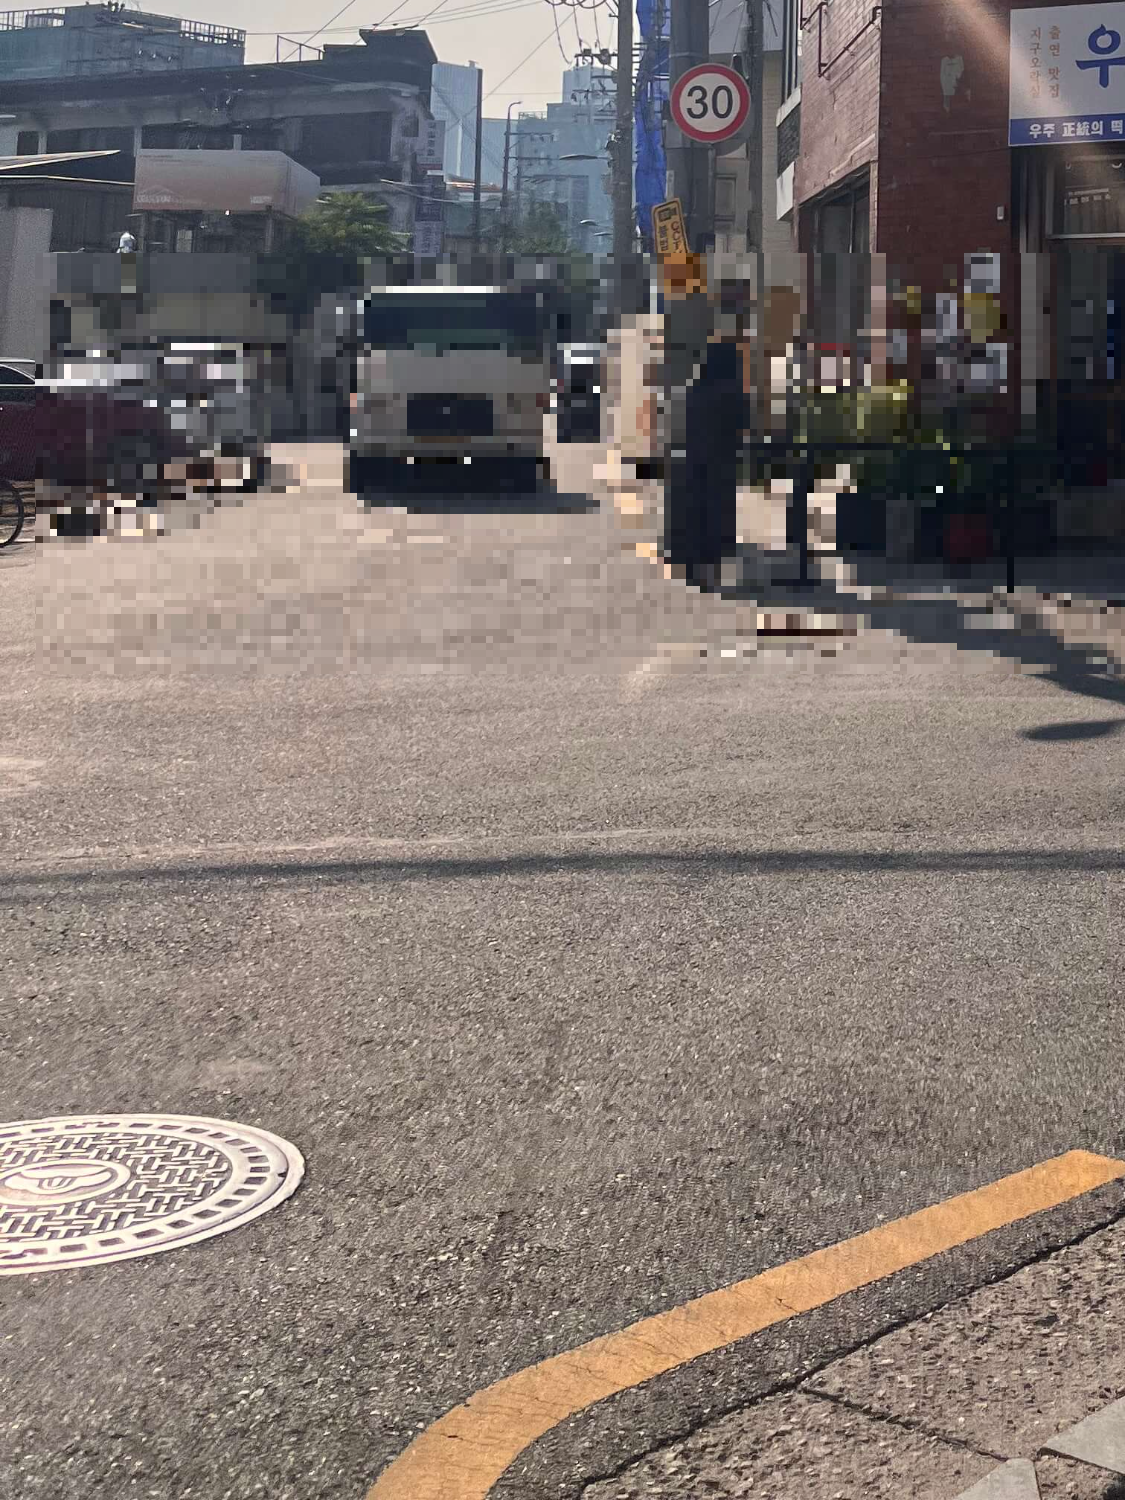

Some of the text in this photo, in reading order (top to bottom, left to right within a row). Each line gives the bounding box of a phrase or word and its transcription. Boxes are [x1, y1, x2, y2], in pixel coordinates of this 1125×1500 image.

[1048, 67, 1061, 98] 맛집
[686, 85, 734, 120] 30
[1029, 122, 1055, 138] 우주
[1111, 119, 1123, 134] 떡
